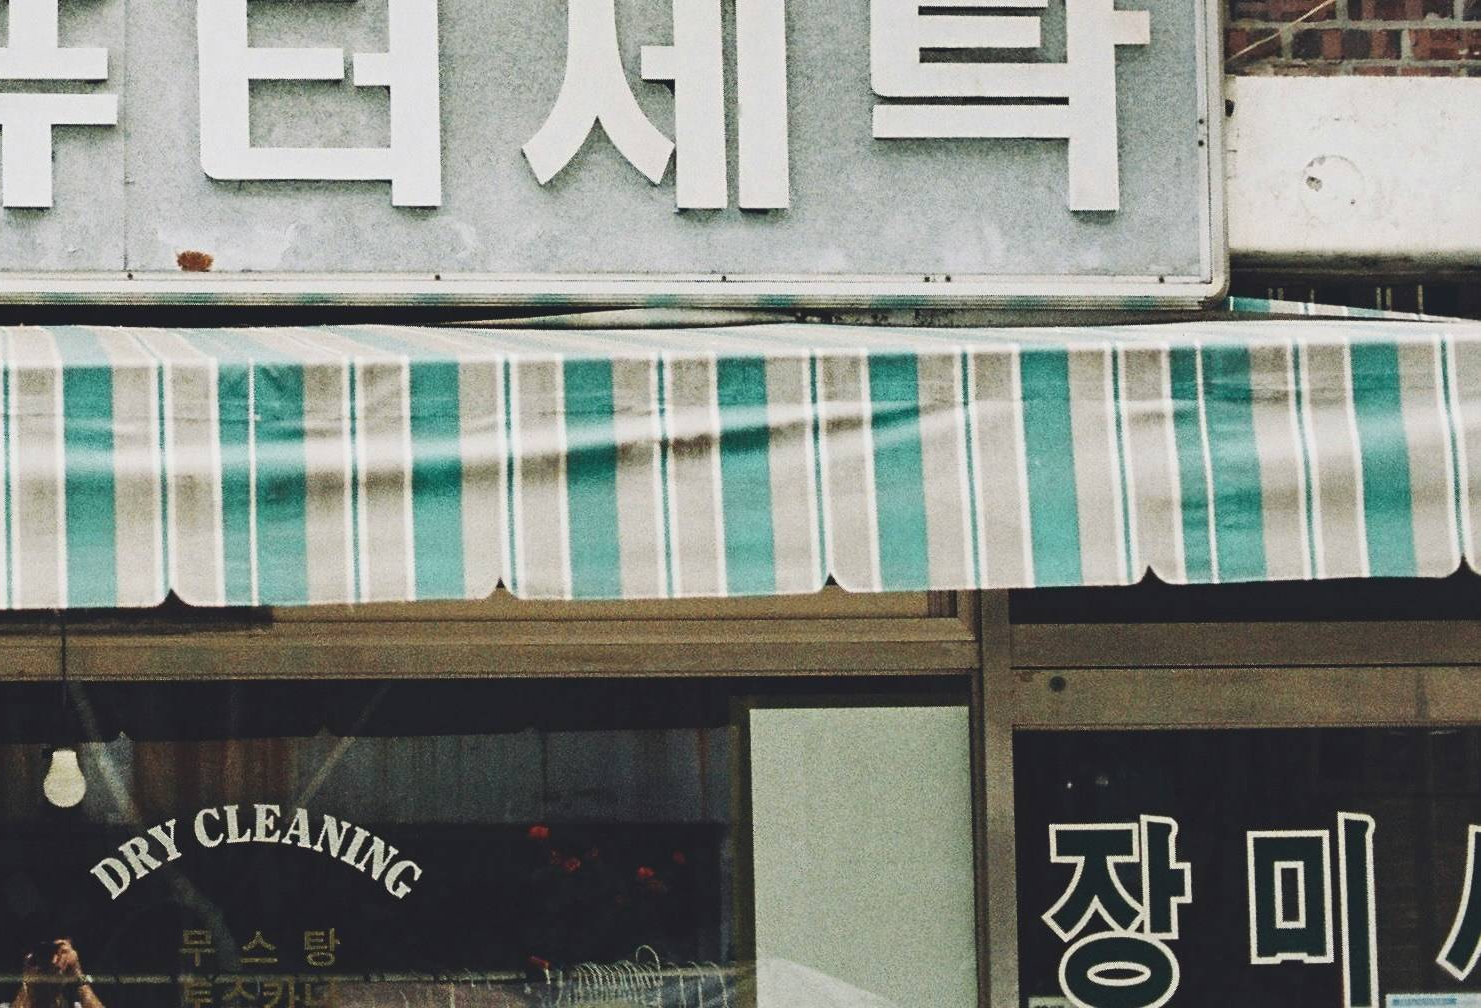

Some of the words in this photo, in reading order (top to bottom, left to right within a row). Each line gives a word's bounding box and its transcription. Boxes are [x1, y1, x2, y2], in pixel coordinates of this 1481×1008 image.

[90, 819, 182, 900] DRY
[193, 803, 423, 899] CLEANING
[180, 927, 341, 968] 무스탕
